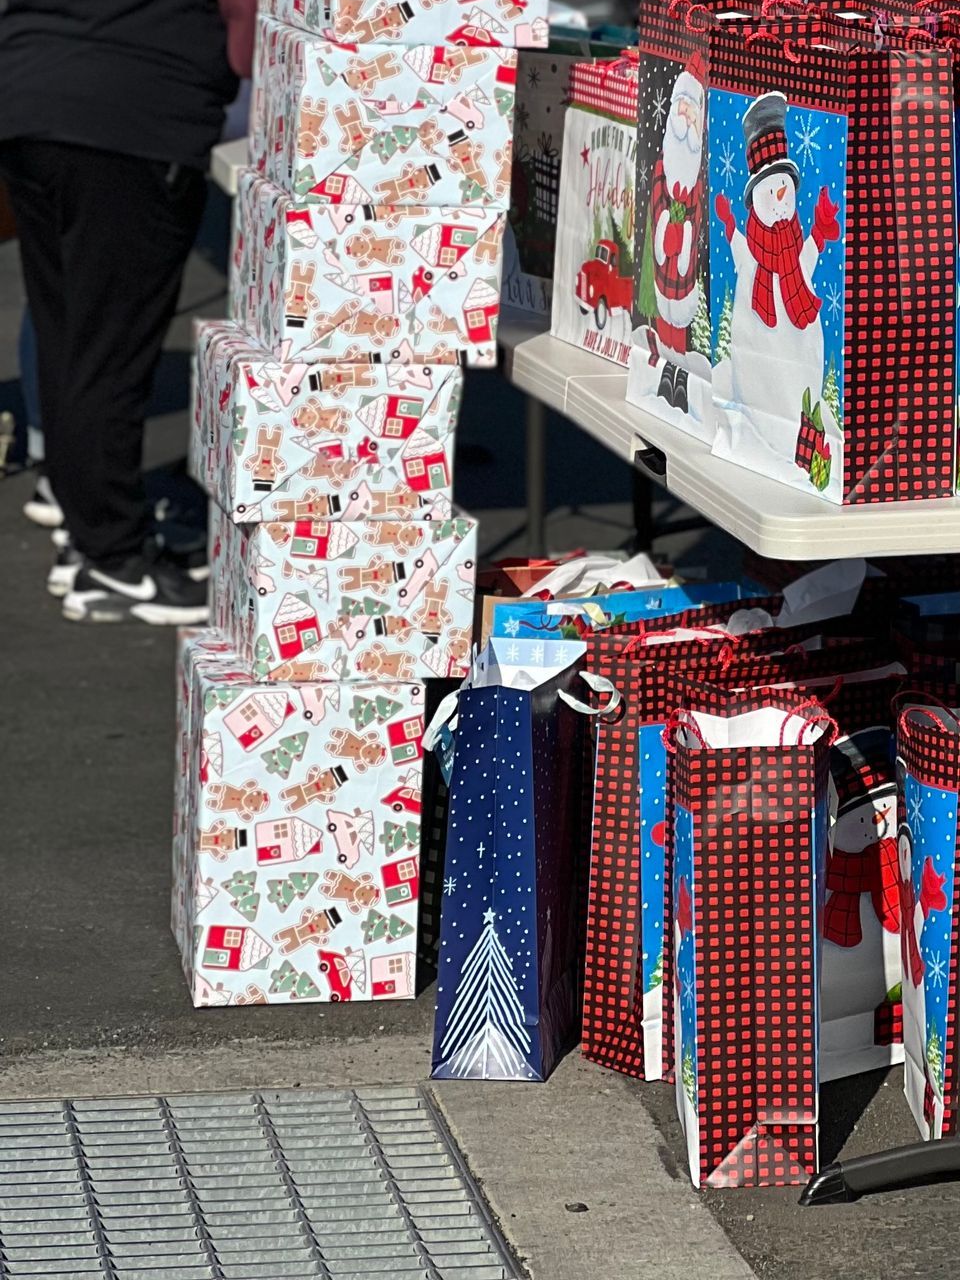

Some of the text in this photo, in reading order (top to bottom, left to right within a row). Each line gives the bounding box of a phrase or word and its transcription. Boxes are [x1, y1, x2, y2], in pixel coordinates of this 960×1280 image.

[591, 125, 637, 163] HOME FOR TH
[583, 329, 631, 365] HAVE A JOLLY TIME
